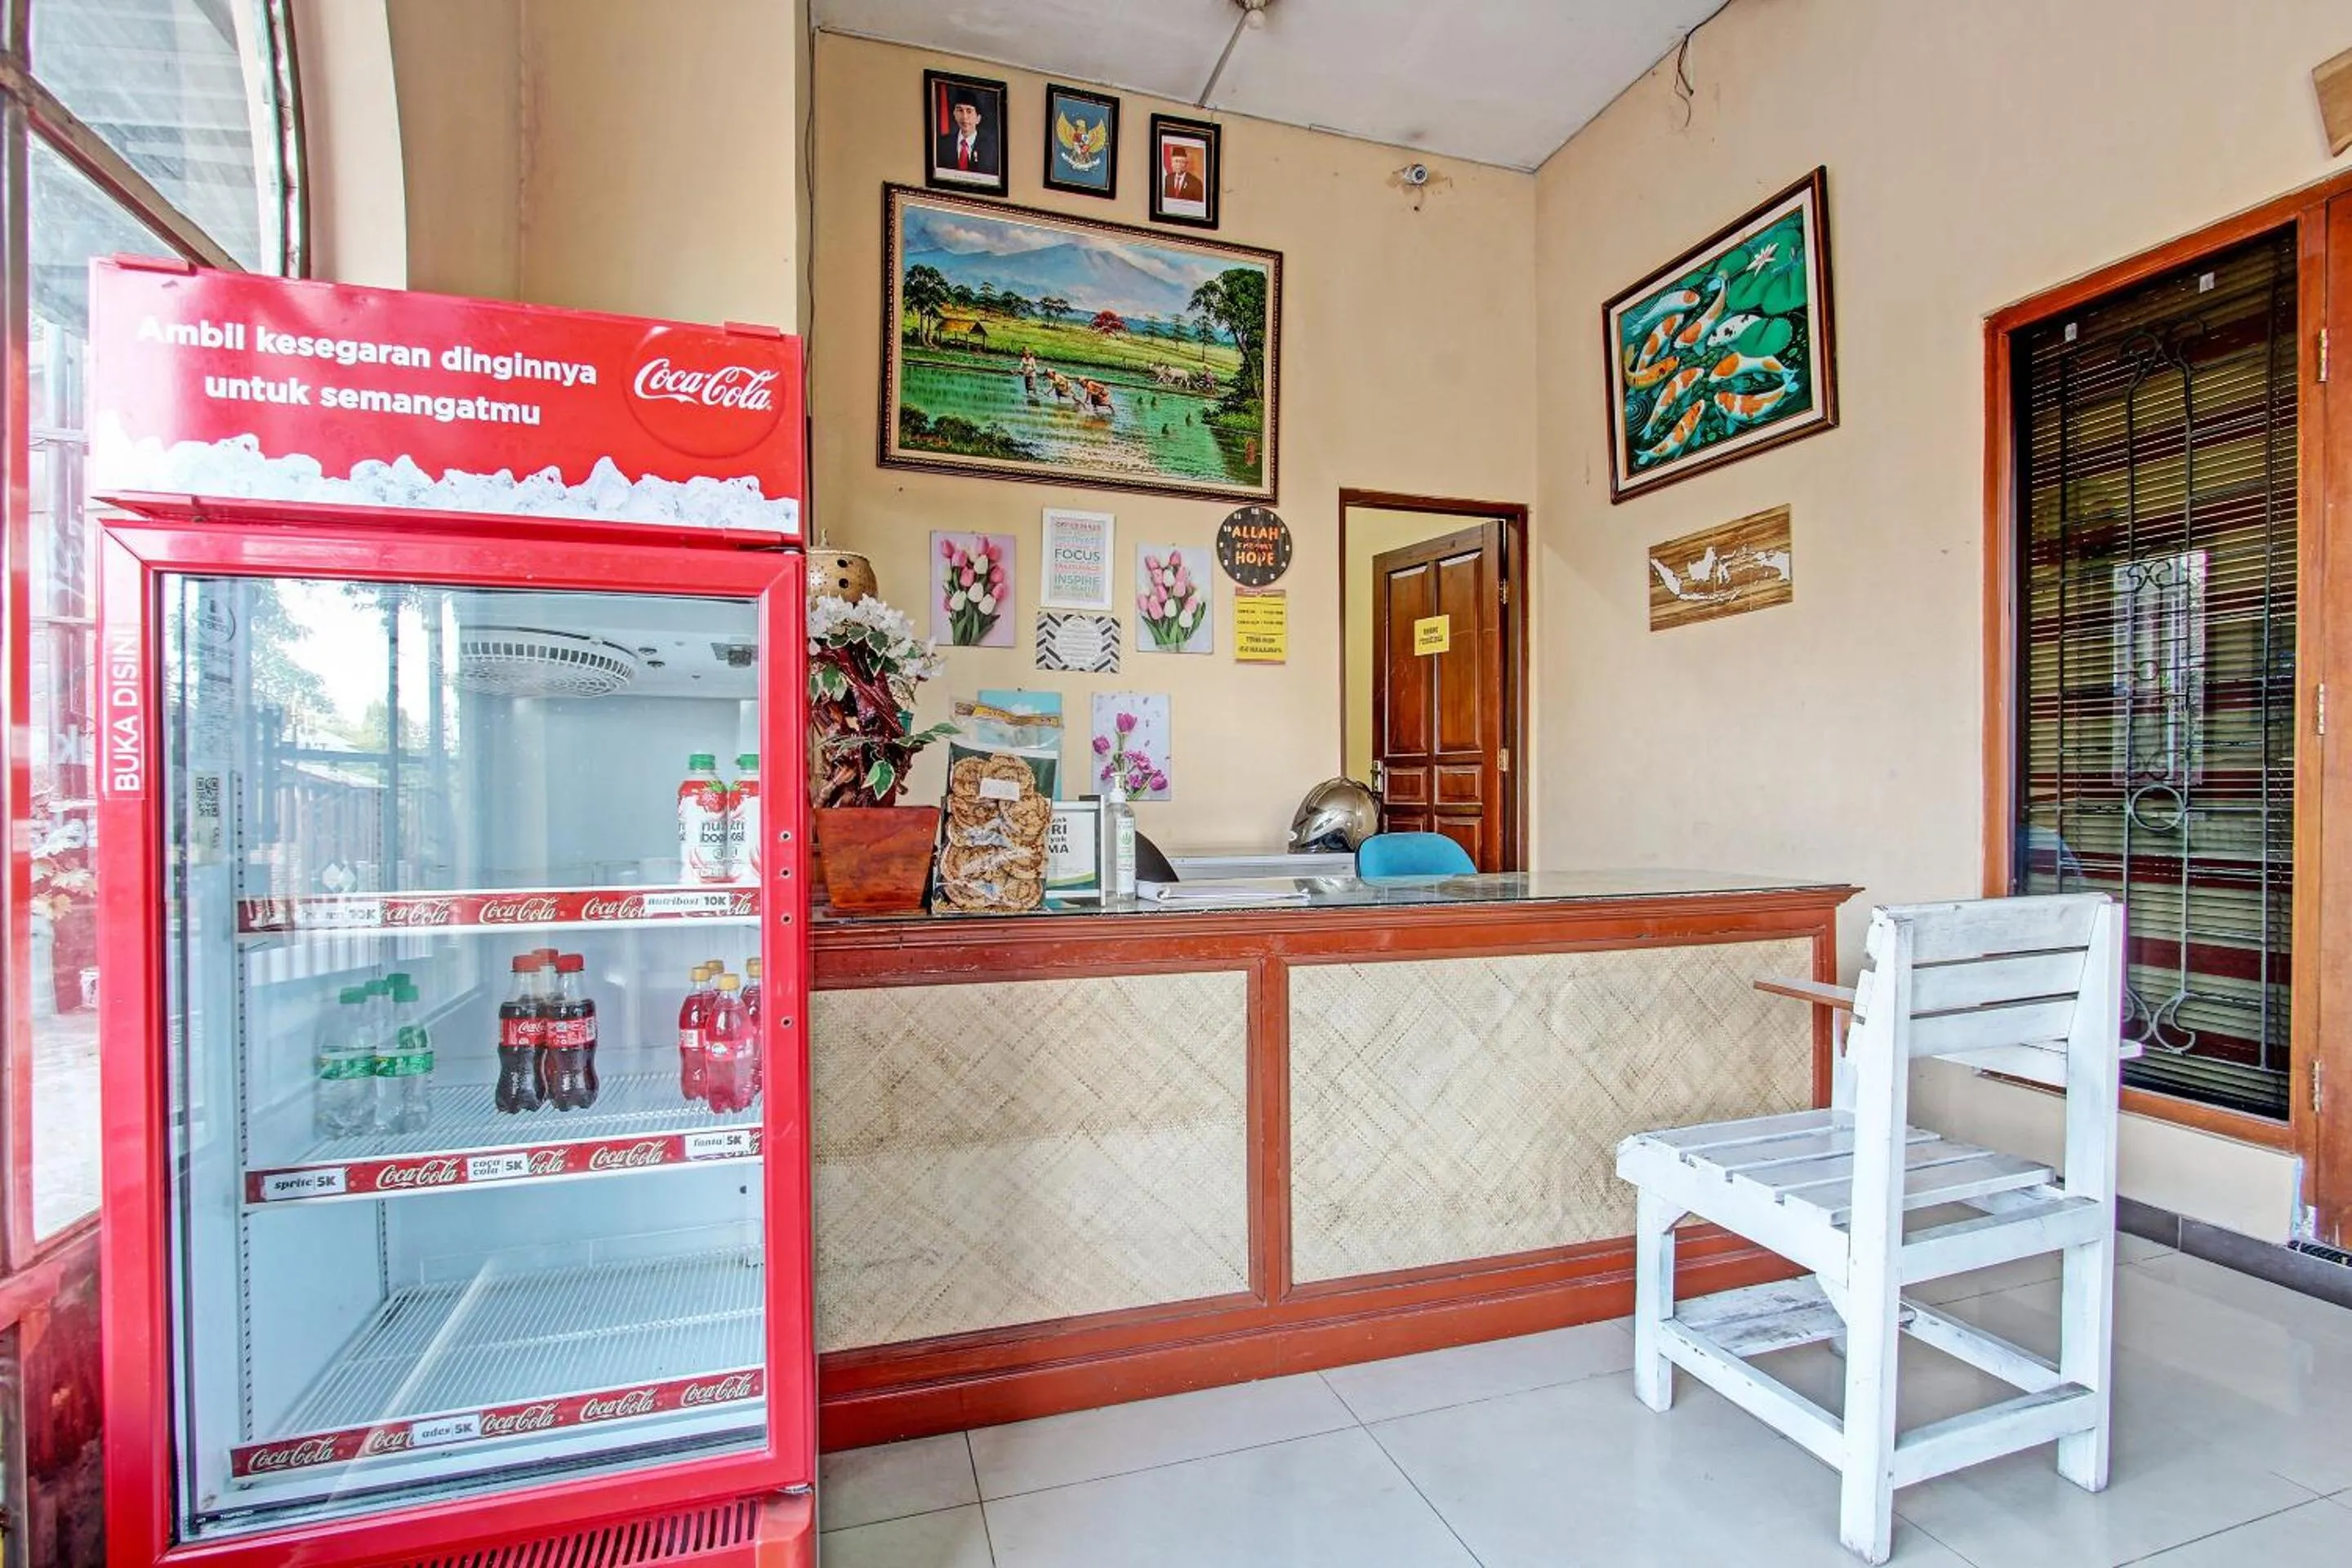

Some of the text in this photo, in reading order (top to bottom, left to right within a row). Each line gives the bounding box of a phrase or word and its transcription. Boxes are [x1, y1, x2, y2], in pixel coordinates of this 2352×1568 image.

[137, 315, 596, 386] Ambil kesegaran dinginnya
[634, 358, 780, 411] Coca-Cola
[205, 376, 540, 425] untuk semangatmu
[1232, 525, 1280, 541] ALLAH
[1054, 548, 1100, 562] FOCUS
[1236, 550, 1274, 567] HOPE
[113, 715, 140, 791] BUKA
[1051, 824, 1067, 835] RI
[1049, 844, 1069, 853] MA
[703, 896, 727, 906] 10K
[479, 898, 559, 924] Coca-Cola
[727, 1136, 742, 1146] 5K
[589, 1141, 666, 1171] Coca-Cola
[473, 1160, 500, 1169] coca
[473, 1166, 498, 1176] cola
[506, 1160, 523, 1170] 5K
[376, 1158, 461, 1190] Coca-Cola
[274, 1176, 336, 1191] sprite 5K
[680, 1374, 754, 1407] Coca-Cola
[580, 1388, 658, 1423] Coca-Cola
[455, 1423, 474, 1435] 5K
[247, 1435, 339, 1473] Coca-Cola
